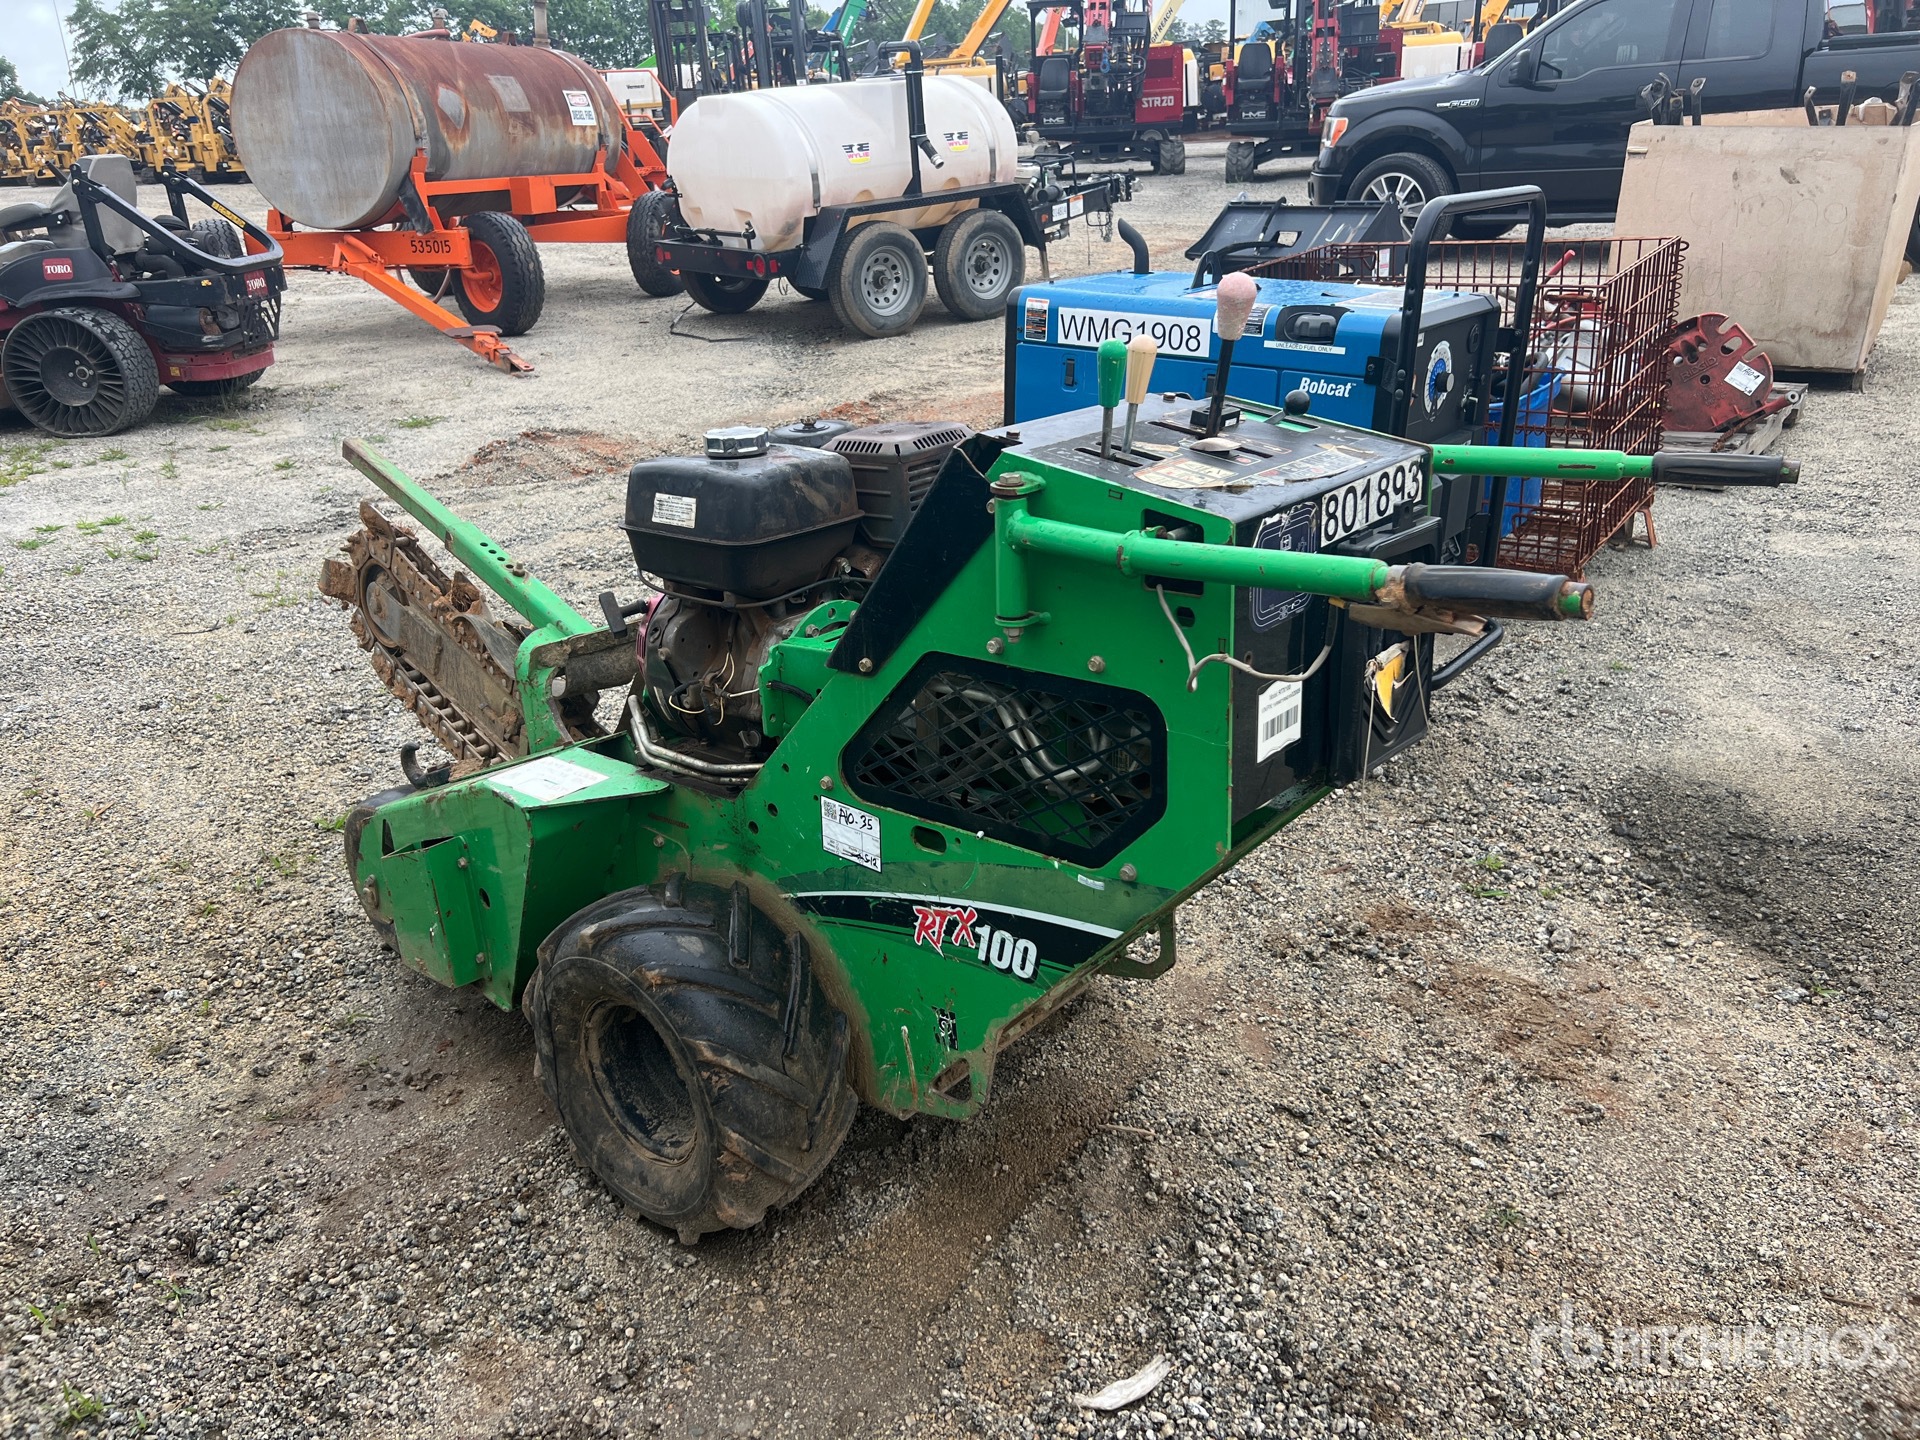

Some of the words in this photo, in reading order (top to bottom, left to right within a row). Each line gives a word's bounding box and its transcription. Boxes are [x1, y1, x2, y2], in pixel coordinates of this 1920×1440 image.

[1158, 7, 1174, 32] REACH
[1142, 96, 1174, 108] STR20
[584, 110, 594, 120] FUEL
[1242, 111, 1266, 119] HMC
[410, 240, 451, 253] 535015
[1060, 314, 1201, 352] WMG1908
[1276, 342, 1303, 350] UNLEADED
[1681, 357, 1717, 380] RIDGID
[1324, 460, 1421, 541] 801893
